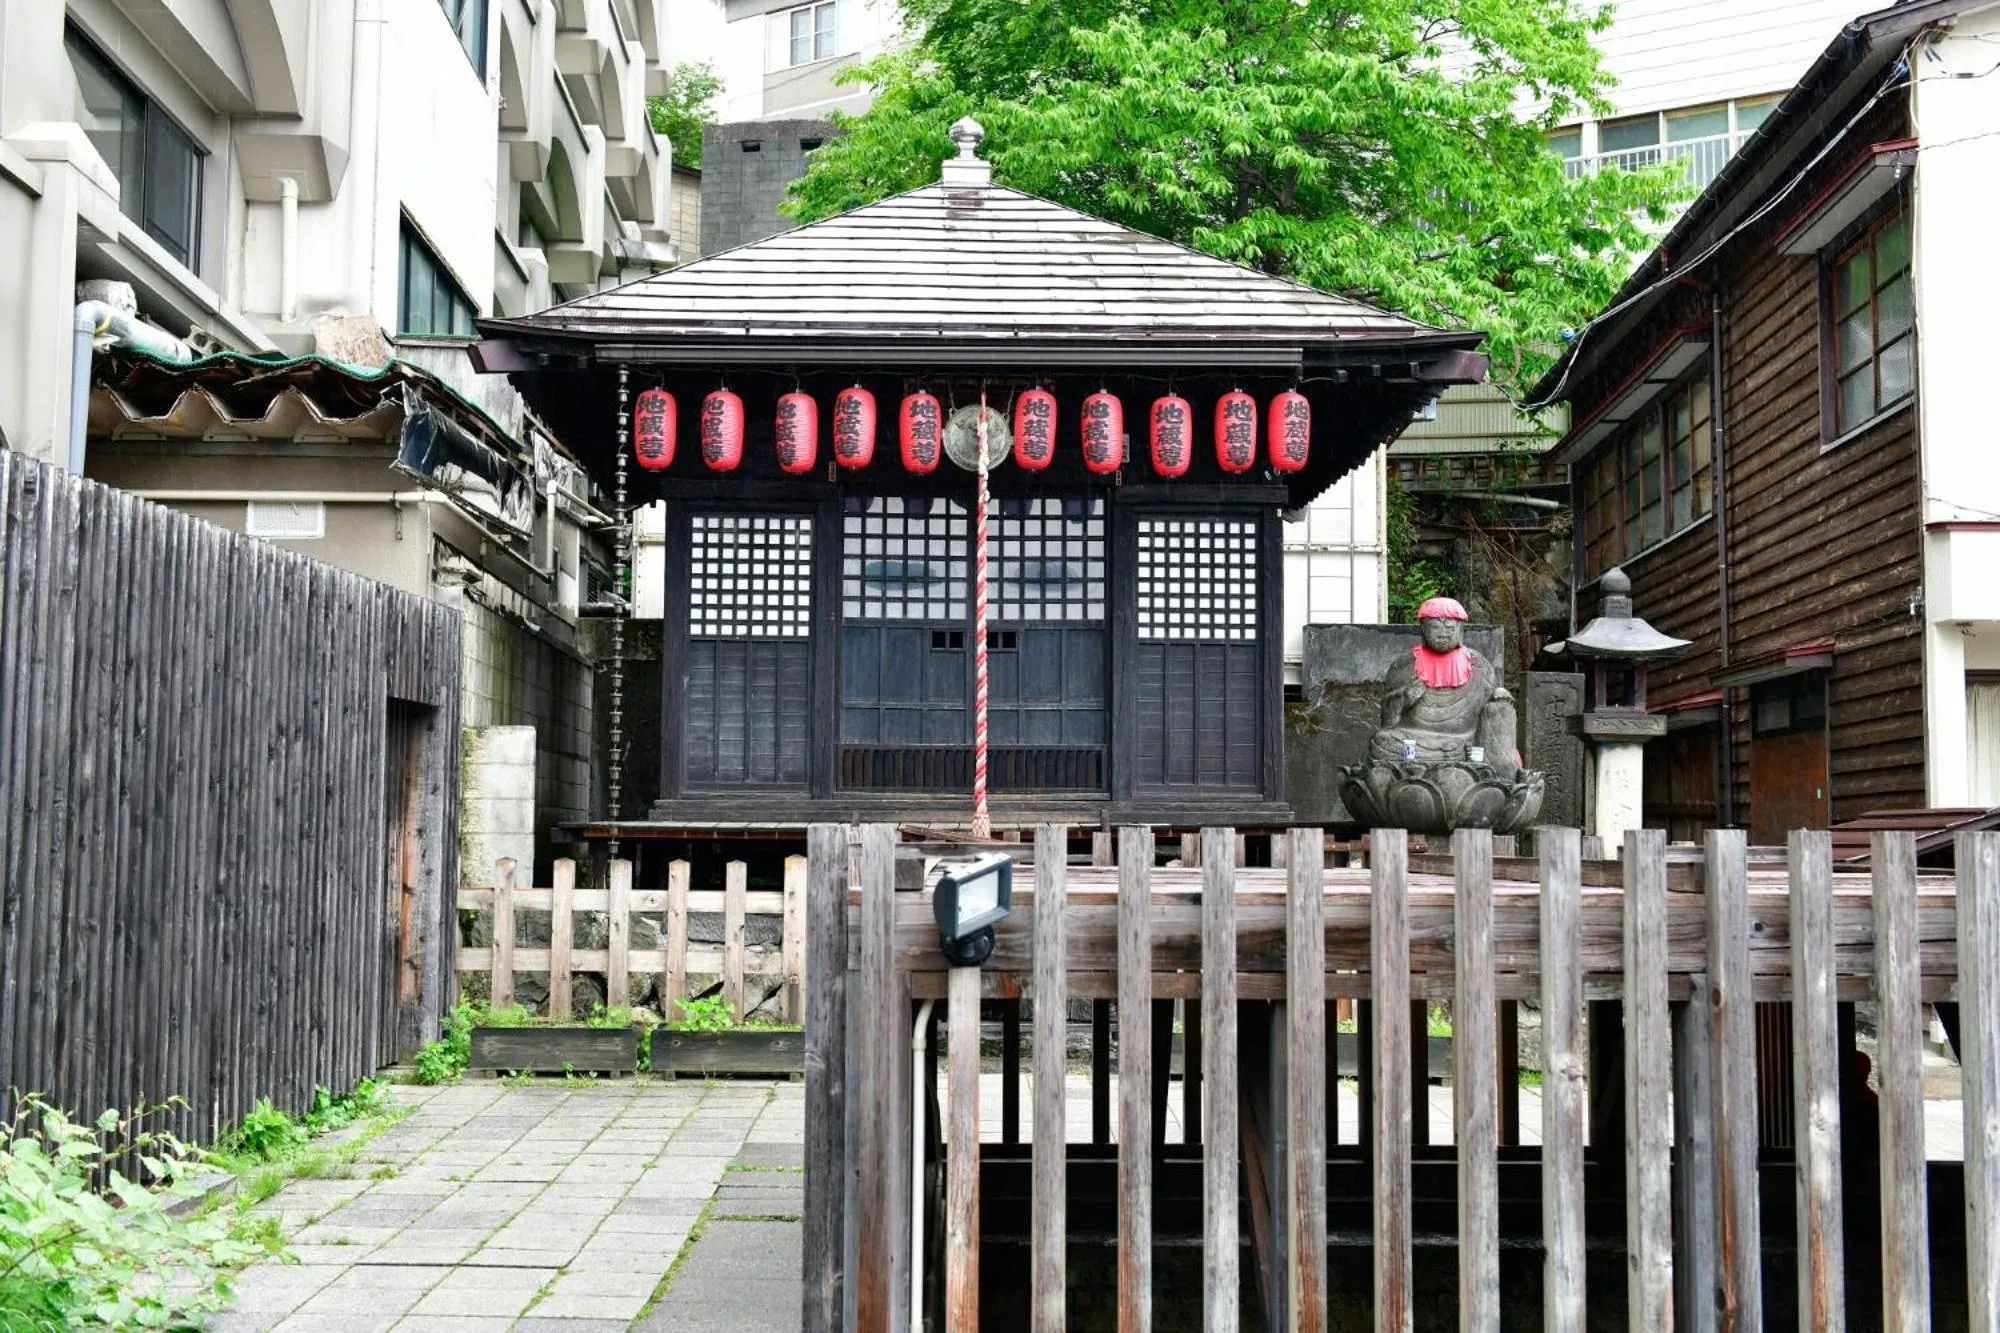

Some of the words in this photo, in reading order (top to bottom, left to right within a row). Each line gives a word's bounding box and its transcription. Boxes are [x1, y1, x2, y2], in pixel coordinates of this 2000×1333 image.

[636, 394, 667, 459] 地蔵尊
[836, 395, 862, 457] 地蔵尊
[910, 400, 937, 464] 地蔵尊
[1023, 398, 1050, 460] 地蔵尊
[1083, 400, 1110, 463] 地蔵尊
[1155, 403, 1184, 467] 地蔵尊
[1223, 400, 1253, 466] 地蔵尊
[1284, 400, 1309, 462] 地蔵尊
